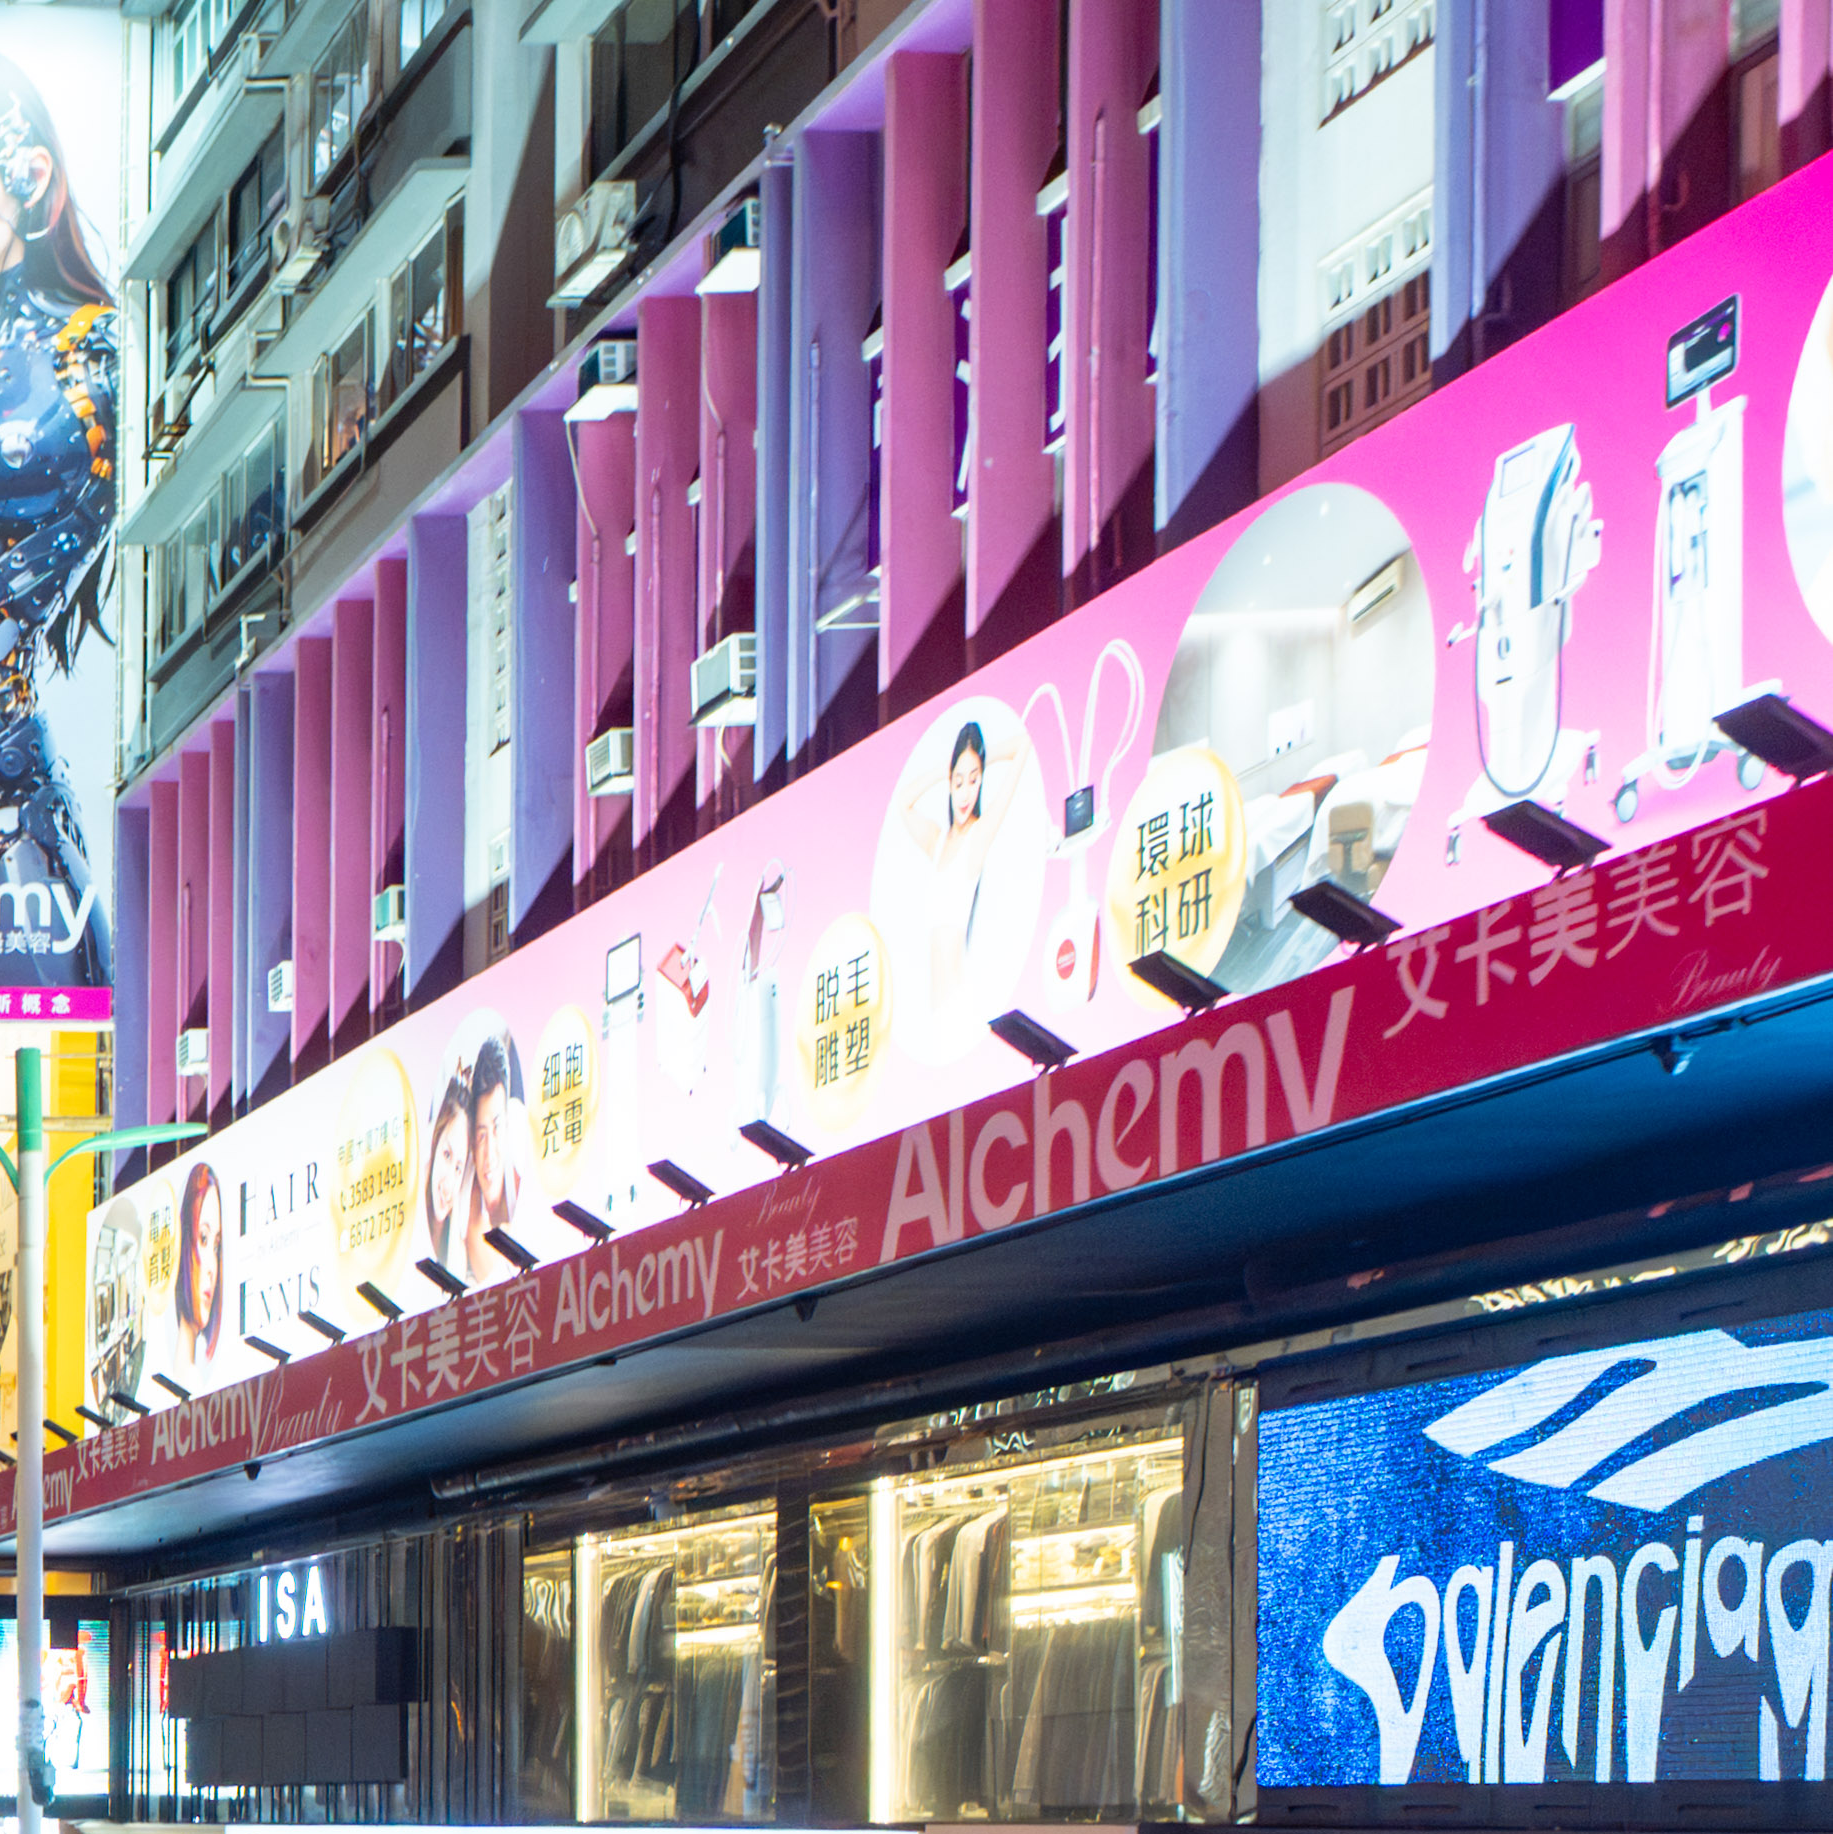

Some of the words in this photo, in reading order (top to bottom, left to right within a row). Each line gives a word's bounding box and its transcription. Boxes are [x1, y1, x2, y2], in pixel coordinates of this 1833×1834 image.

[1136, 791, 1215, 882] 環球
[1135, 866, 1214, 954] 科研
[542, 1042, 584, 1101] 細胞
[814, 1016, 871, 1092] 雕塑
[76, 1422, 141, 1484] 艾卡美美容
[150, 1374, 267, 1466] Alchemy
[354, 1280, 542, 1425] 艾卡美美容
[551, 1230, 724, 1343] Alchemy
[736, 1216, 859, 1301] 艾卡美美容
[1382, 808, 1770, 1040] 艾卡美美容
[541, 1097, 583, 1160] 充電
[240, 1160, 320, 1238] HAIR
[348, 1174, 375, 1211] 3583
[376, 1161, 404, 1197] 1491
[349, 1214, 375, 1249] 6872
[377, 1199, 406, 1236] 7575
[257, 1563, 329, 1644] ISA
